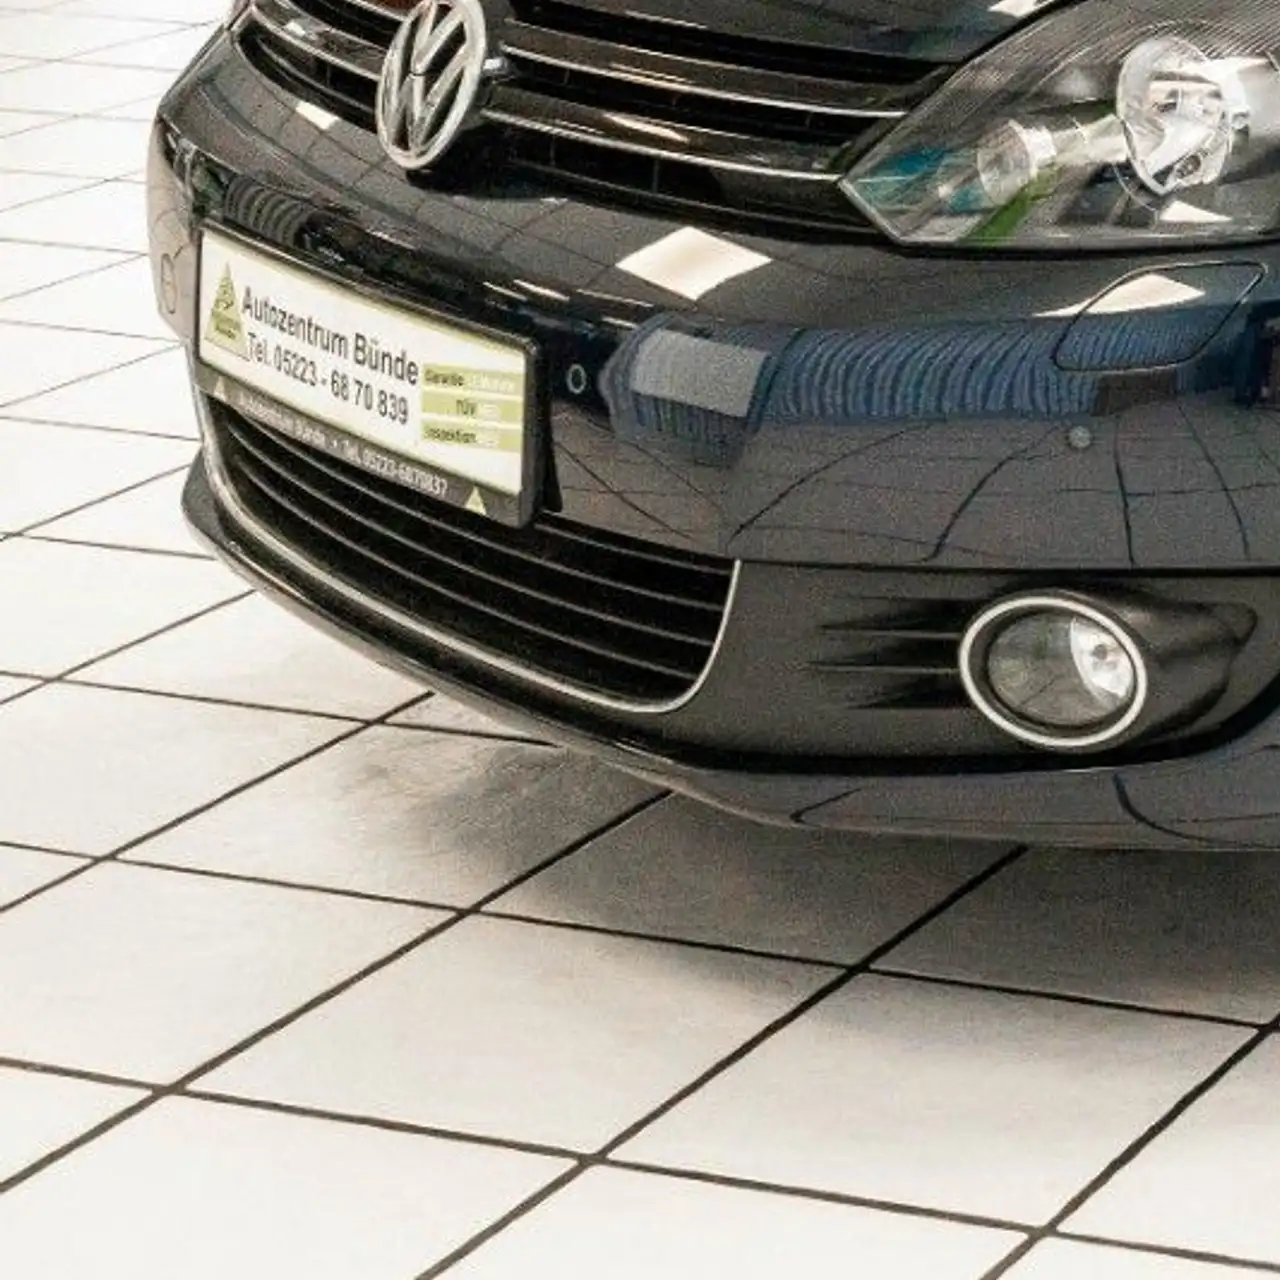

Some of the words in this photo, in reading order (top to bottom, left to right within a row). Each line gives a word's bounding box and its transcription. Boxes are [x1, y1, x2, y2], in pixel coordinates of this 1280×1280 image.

[241, 285, 348, 360] Autozentrum
[353, 331, 419, 386] Bünde
[275, 345, 318, 388] 05223
[330, 368, 350, 402] 68
[353, 379, 374, 411] 70
[376, 388, 409, 425] 839
